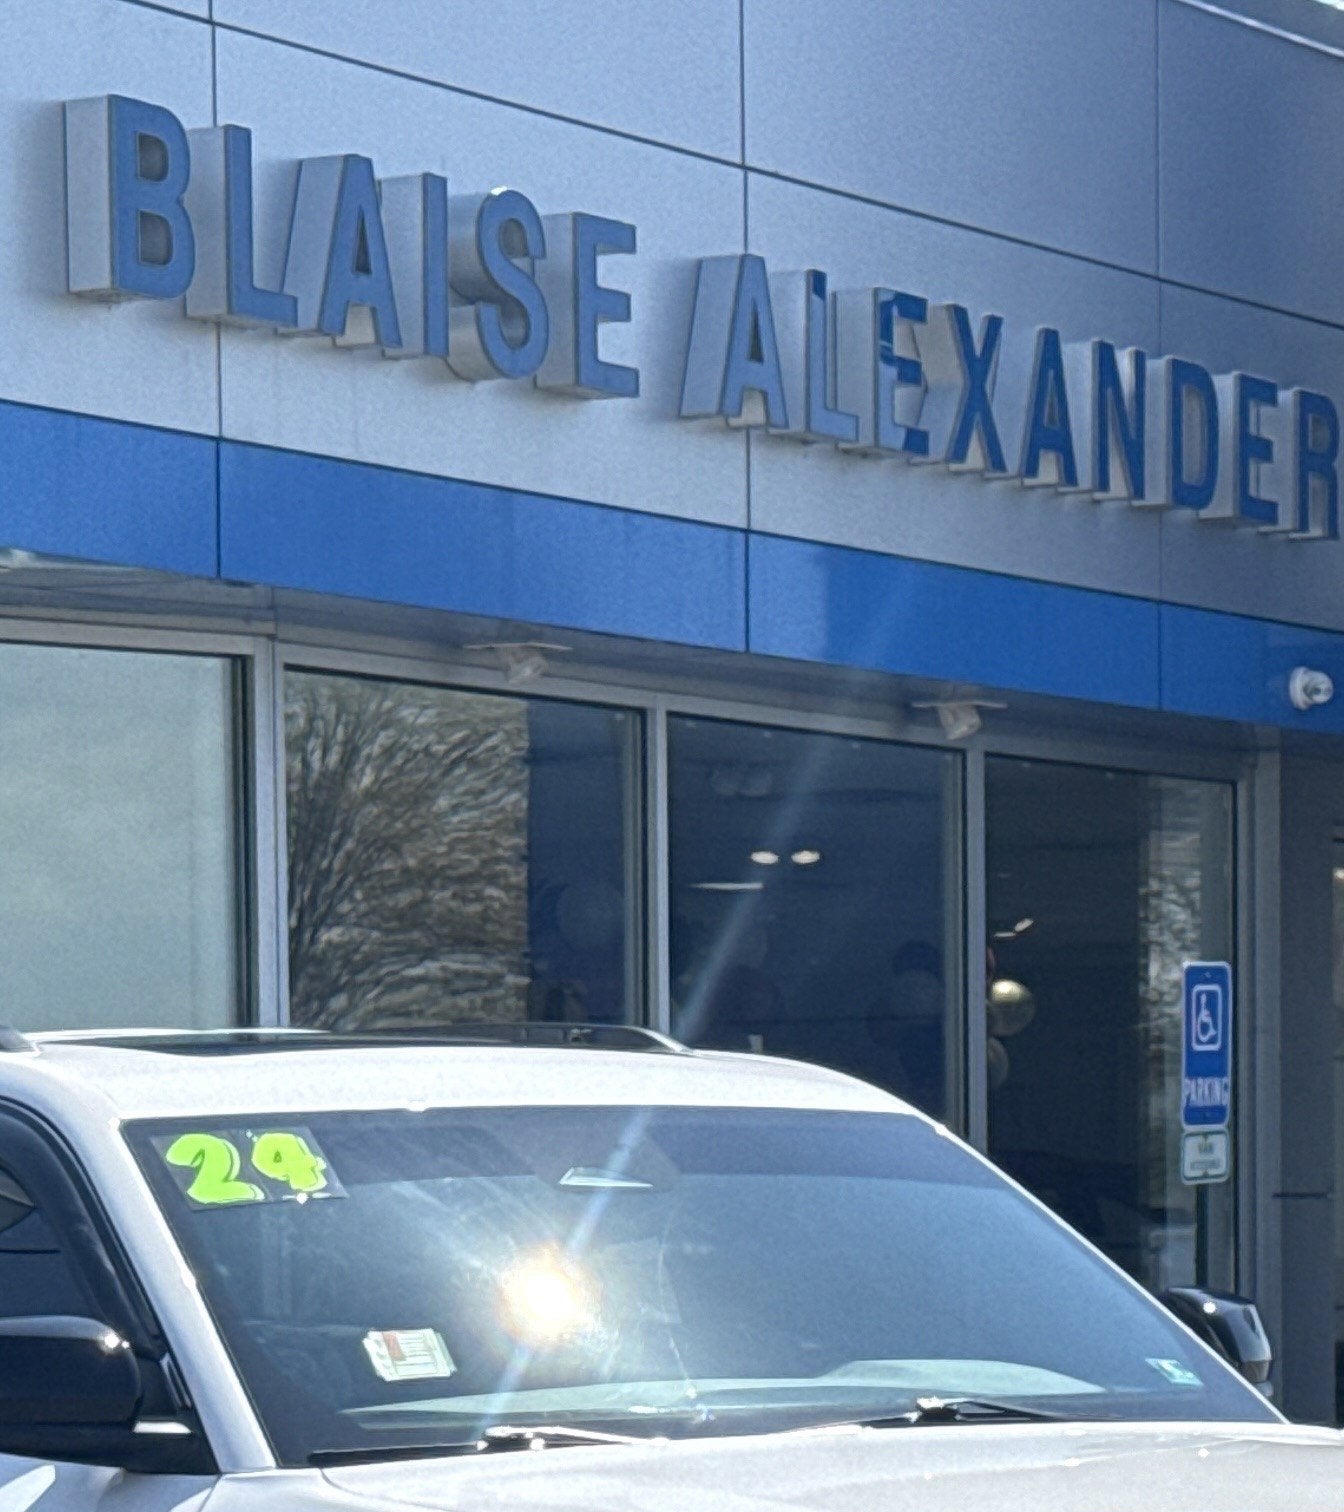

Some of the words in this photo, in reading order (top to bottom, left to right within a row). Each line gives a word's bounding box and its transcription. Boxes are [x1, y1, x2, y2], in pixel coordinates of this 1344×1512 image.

[66, 93, 641, 400] BLAISE
[682, 252, 1341, 541] ALEXANDER
[1184, 1077, 1229, 1107] PARKING
[165, 1132, 328, 1204] 24
